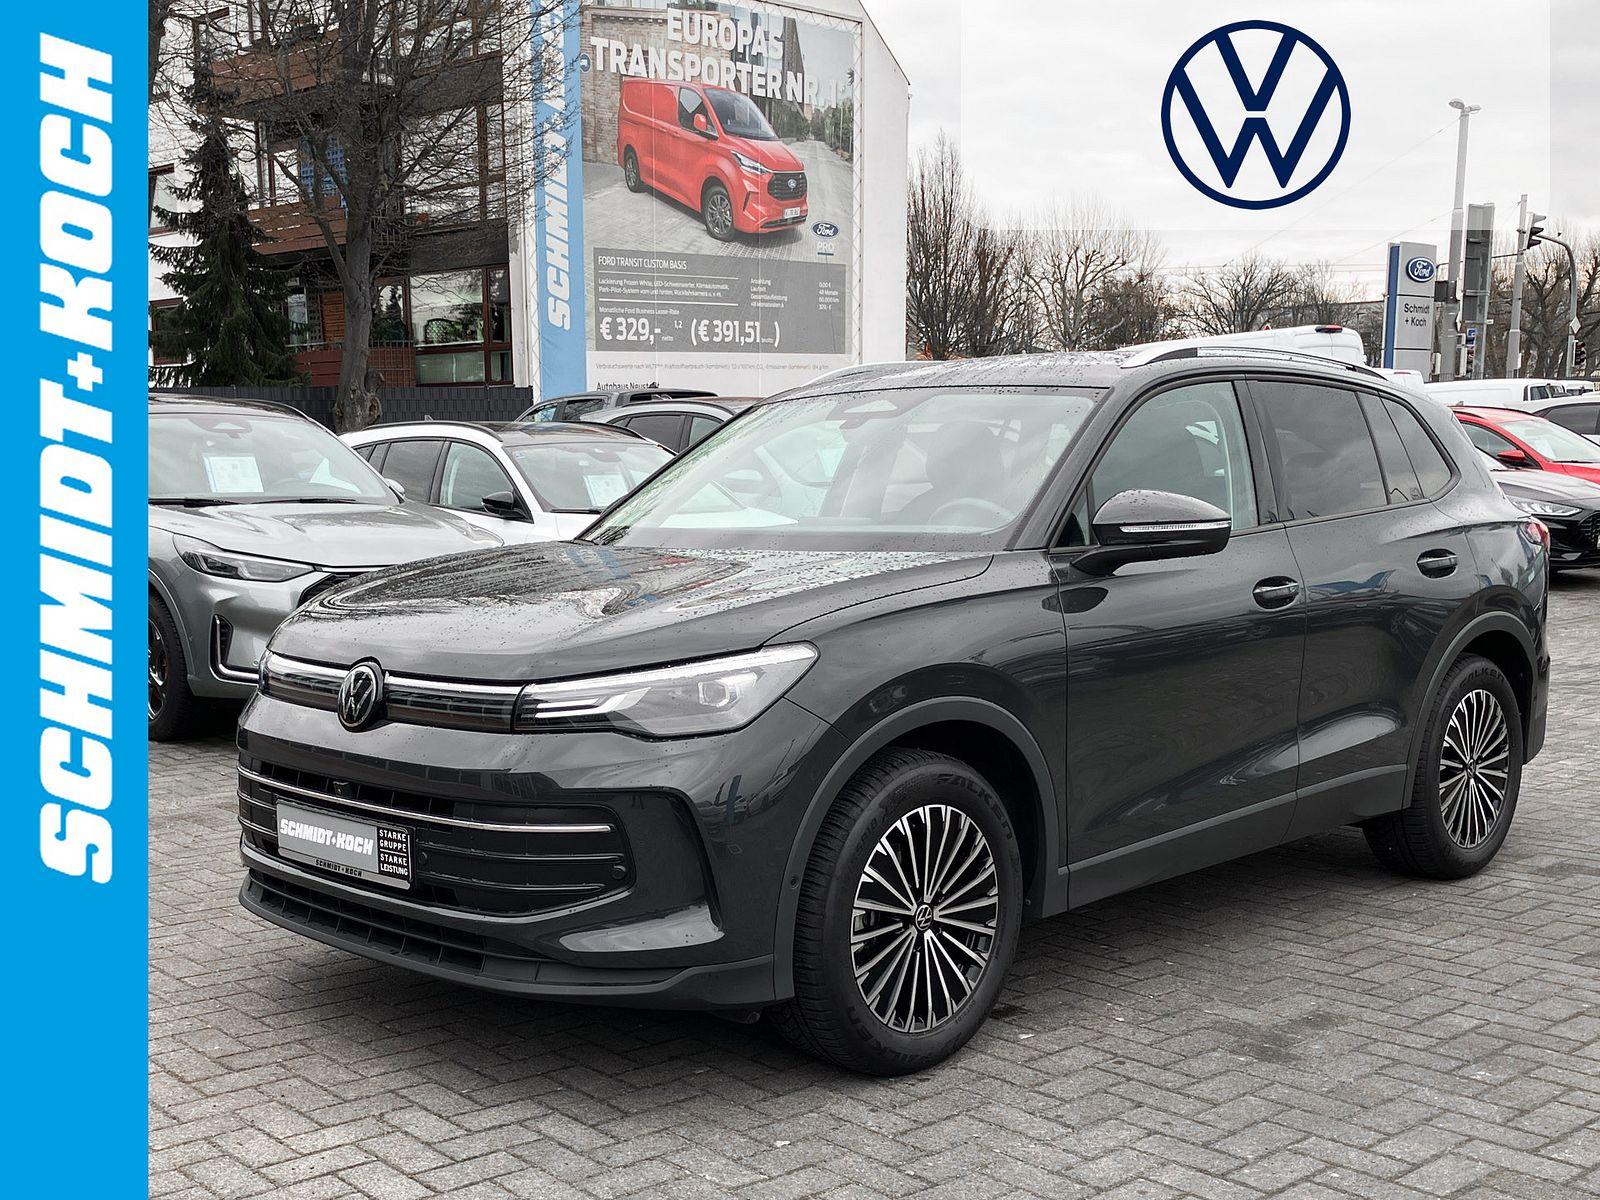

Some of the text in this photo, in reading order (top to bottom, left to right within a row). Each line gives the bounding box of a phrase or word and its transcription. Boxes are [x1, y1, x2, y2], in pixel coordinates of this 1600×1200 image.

[667, 8, 785, 61] EUROPAS
[591, 37, 782, 100] TRANSPORTER
[815, 222, 836, 237] Ford
[817, 241, 835, 251] PRO
[598, 256, 687, 270] FORD TRANSIT CUSTOM BASIS
[1412, 259, 1432, 278] Ford
[1404, 303, 1430, 314] Schmidt
[1411, 317, 1427, 327] Koch
[600, 317, 612, 340] €
[616, 317, 661, 344] 329,-
[713, 319, 760, 346] 391,51
[280, 818, 374, 856] SCHMIDT+KOCH
[379, 829, 407, 842] STARKE
[380, 839, 407, 852] GRUPPE
[380, 853, 408, 866] STARKE
[380, 863, 409, 877] LEISTUNG
